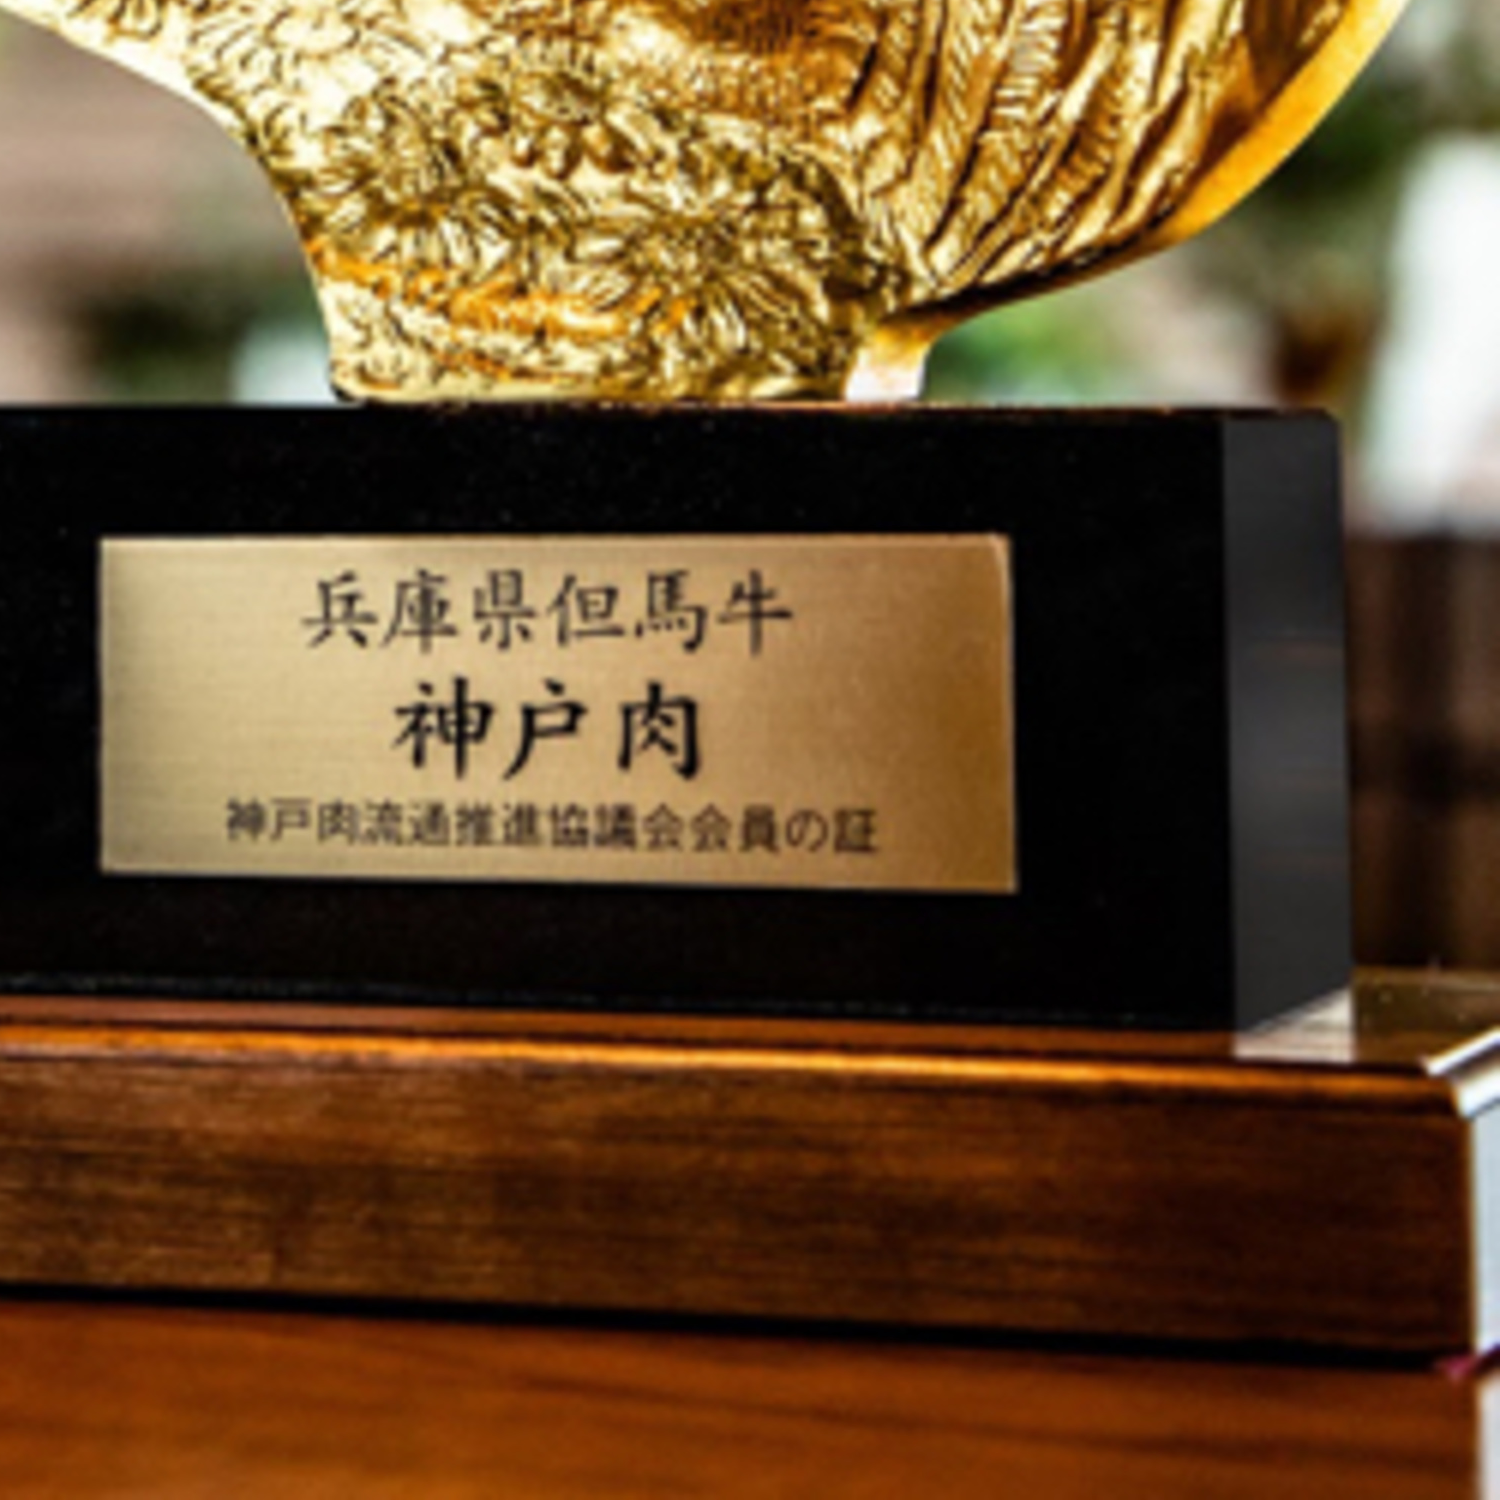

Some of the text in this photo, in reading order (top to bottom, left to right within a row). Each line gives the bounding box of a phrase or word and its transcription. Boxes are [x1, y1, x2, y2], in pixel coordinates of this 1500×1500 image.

[302, 568, 794, 657] 兵庫県但馬牛
[391, 675, 703, 781] 神戸肉
[224, 798, 879, 855] 神戸肉流通推進協議会会員の証
